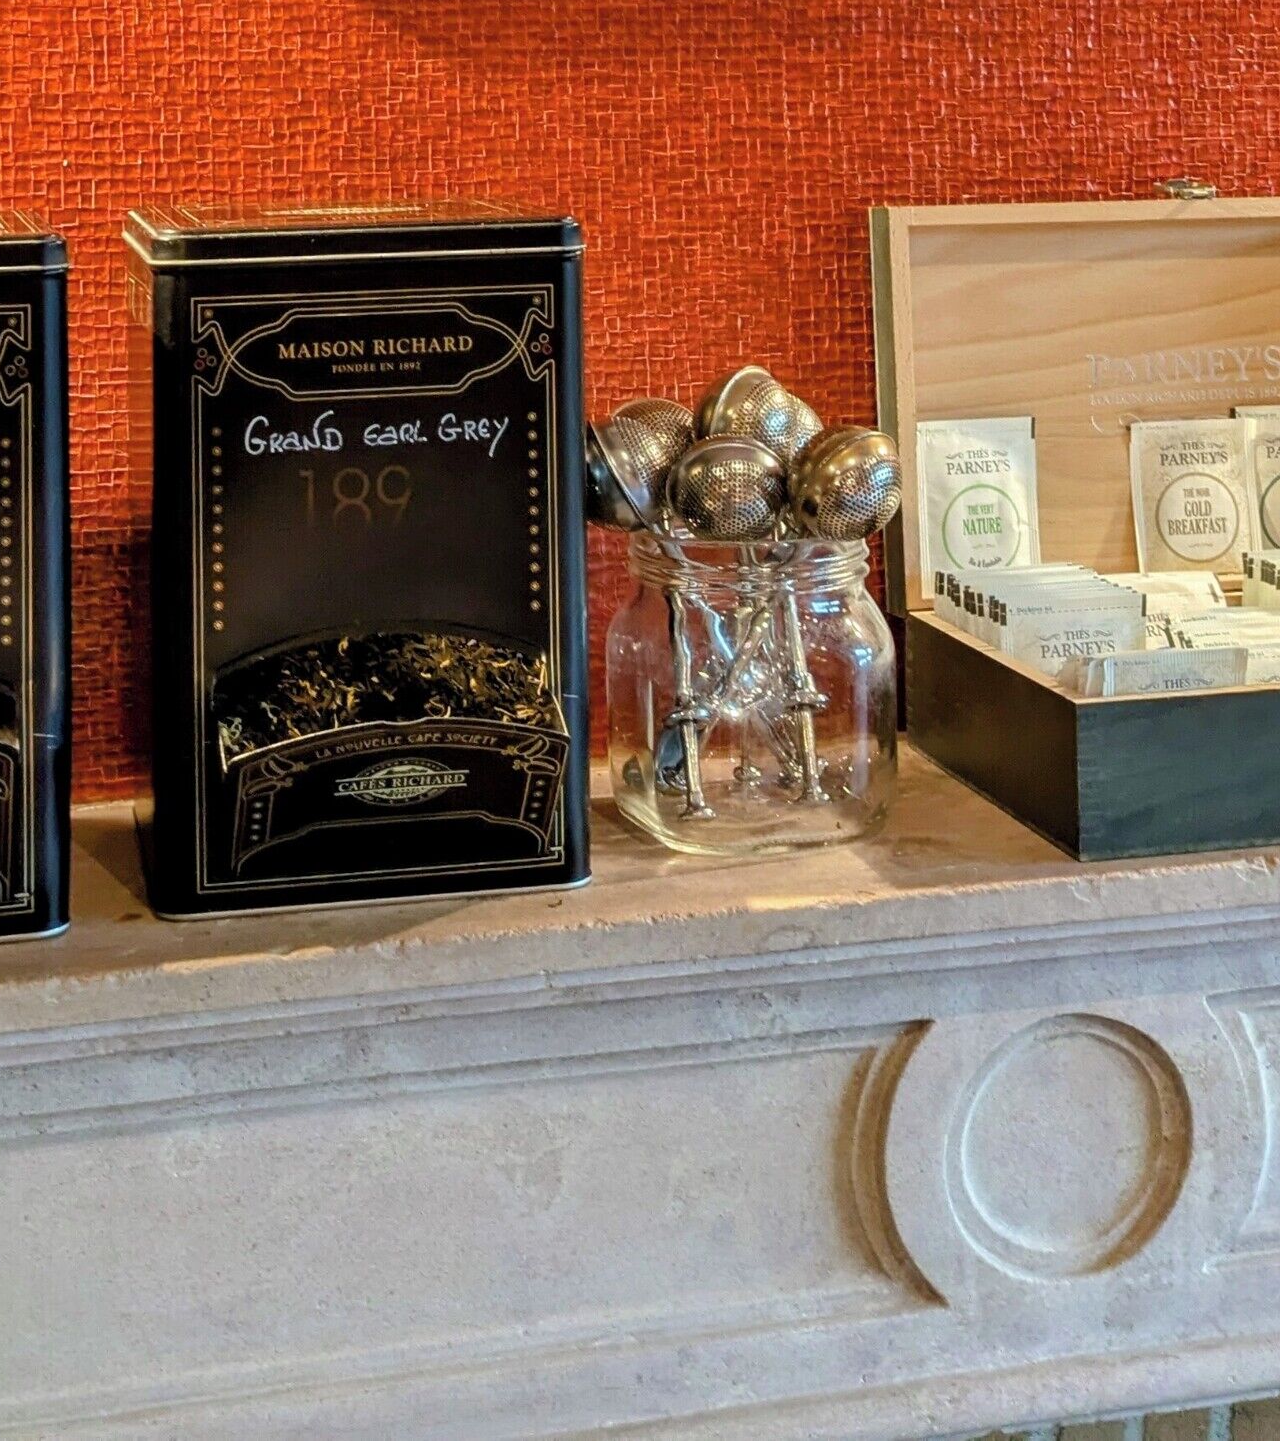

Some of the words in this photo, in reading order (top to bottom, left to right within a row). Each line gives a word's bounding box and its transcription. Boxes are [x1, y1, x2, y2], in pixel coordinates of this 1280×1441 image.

[278, 339, 365, 360] MAISON
[373, 334, 474, 356] RICHARD
[331, 363, 377, 375] FONDÉE
[379, 362, 397, 373] EN
[398, 361, 422, 372] 1892
[946, 459, 1011, 476] PARNEY'S
[1160, 451, 1229, 466] PARNEY'S
[298, 464, 413, 528] 189
[1184, 500, 1212, 517] GOLD
[962, 516, 1003, 536] NATURE
[1167, 517, 1227, 536] BREAKFAST
[335, 735, 401, 755] NOUVELLE
[391, 773, 466, 788] RICHARD
